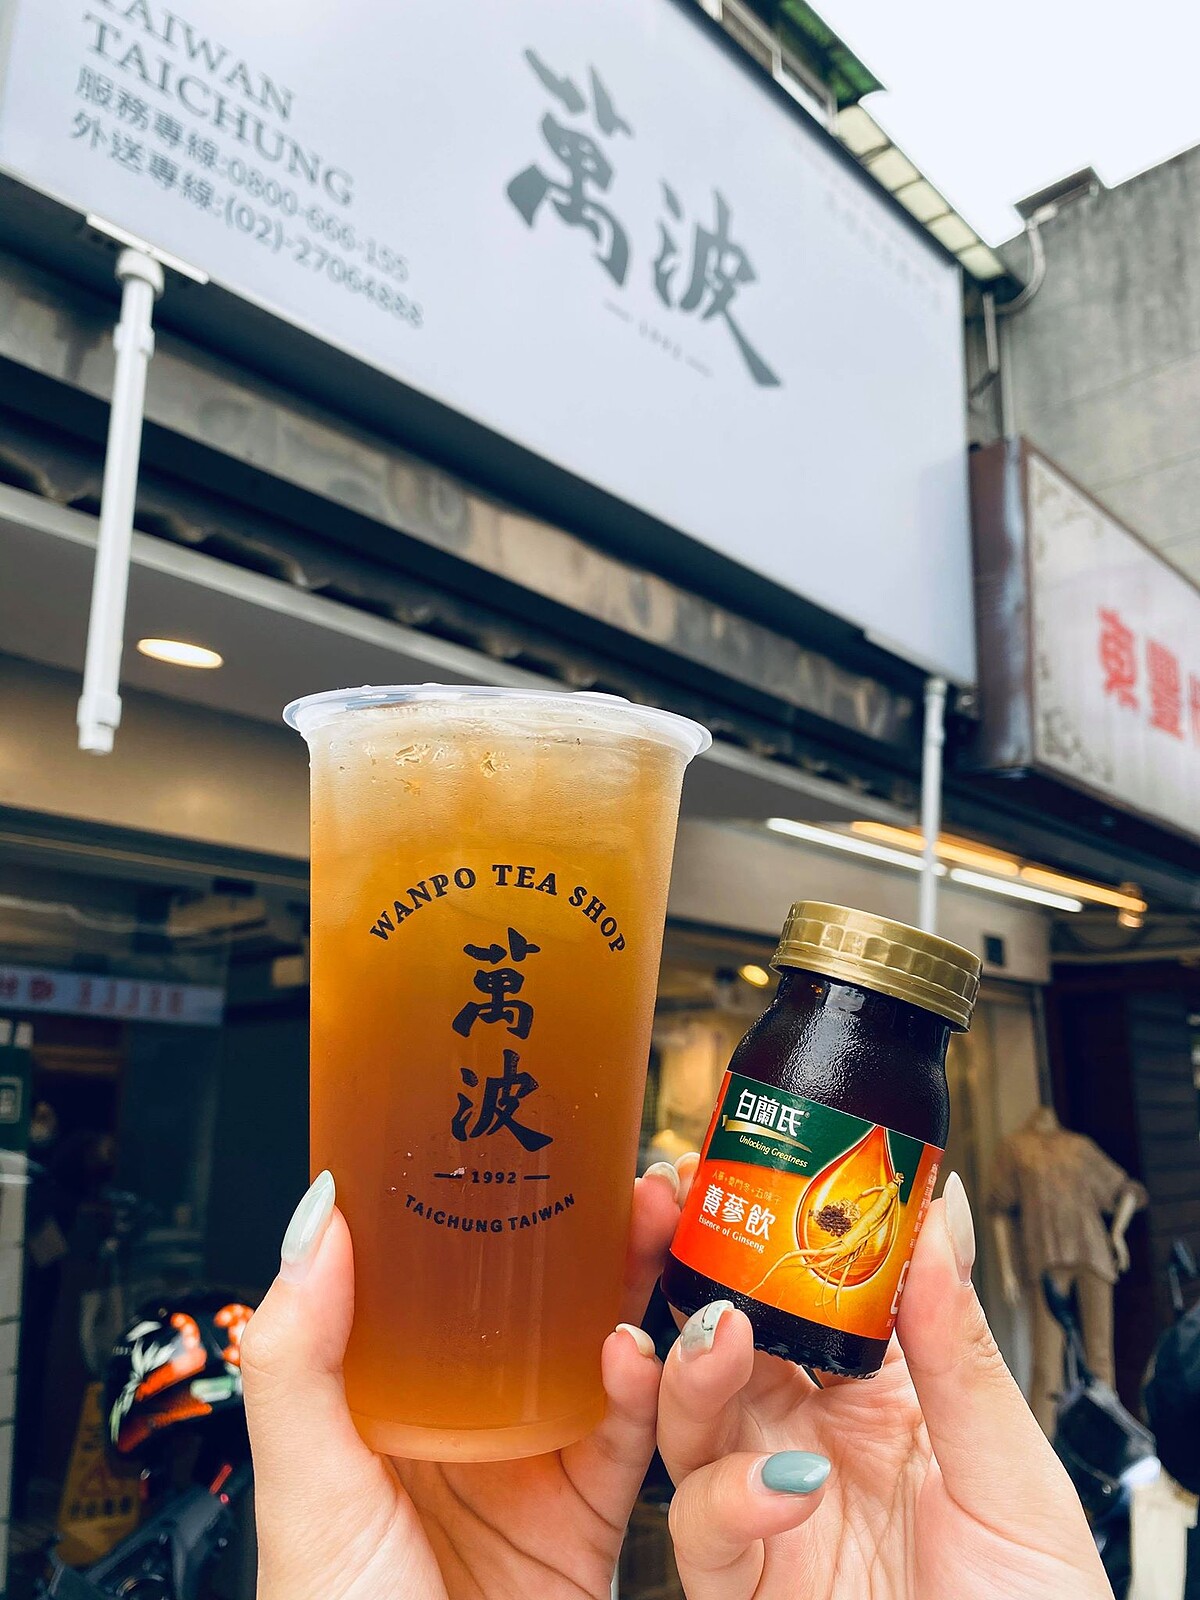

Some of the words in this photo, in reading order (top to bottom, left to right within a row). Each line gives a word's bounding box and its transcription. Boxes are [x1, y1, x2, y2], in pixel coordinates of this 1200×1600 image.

[100, 0, 296, 122] AIWAN
[83, 10, 354, 208] TAICHUNG
[506, 47, 782, 388] 萬波
[369, 867, 476, 941] WANPO
[492, 864, 558, 896] TEA
[568, 886, 626, 953] SHOP
[450, 926, 554, 1152] 萬波
[735, 1088, 805, 1137] 白蘭氏
[471, 1171, 518, 1184] 1992
[739, 1134, 771, 1155] Unlocking
[771, 1147, 809, 1168] Greatness
[405, 1194, 503, 1233] TAICHUNG
[508, 1193, 575, 1231] TAIWAN
[698, 1214, 721, 1232] Essence
[722, 1227, 731, 1237] of
[732, 1231, 765, 1254] Ginseng
